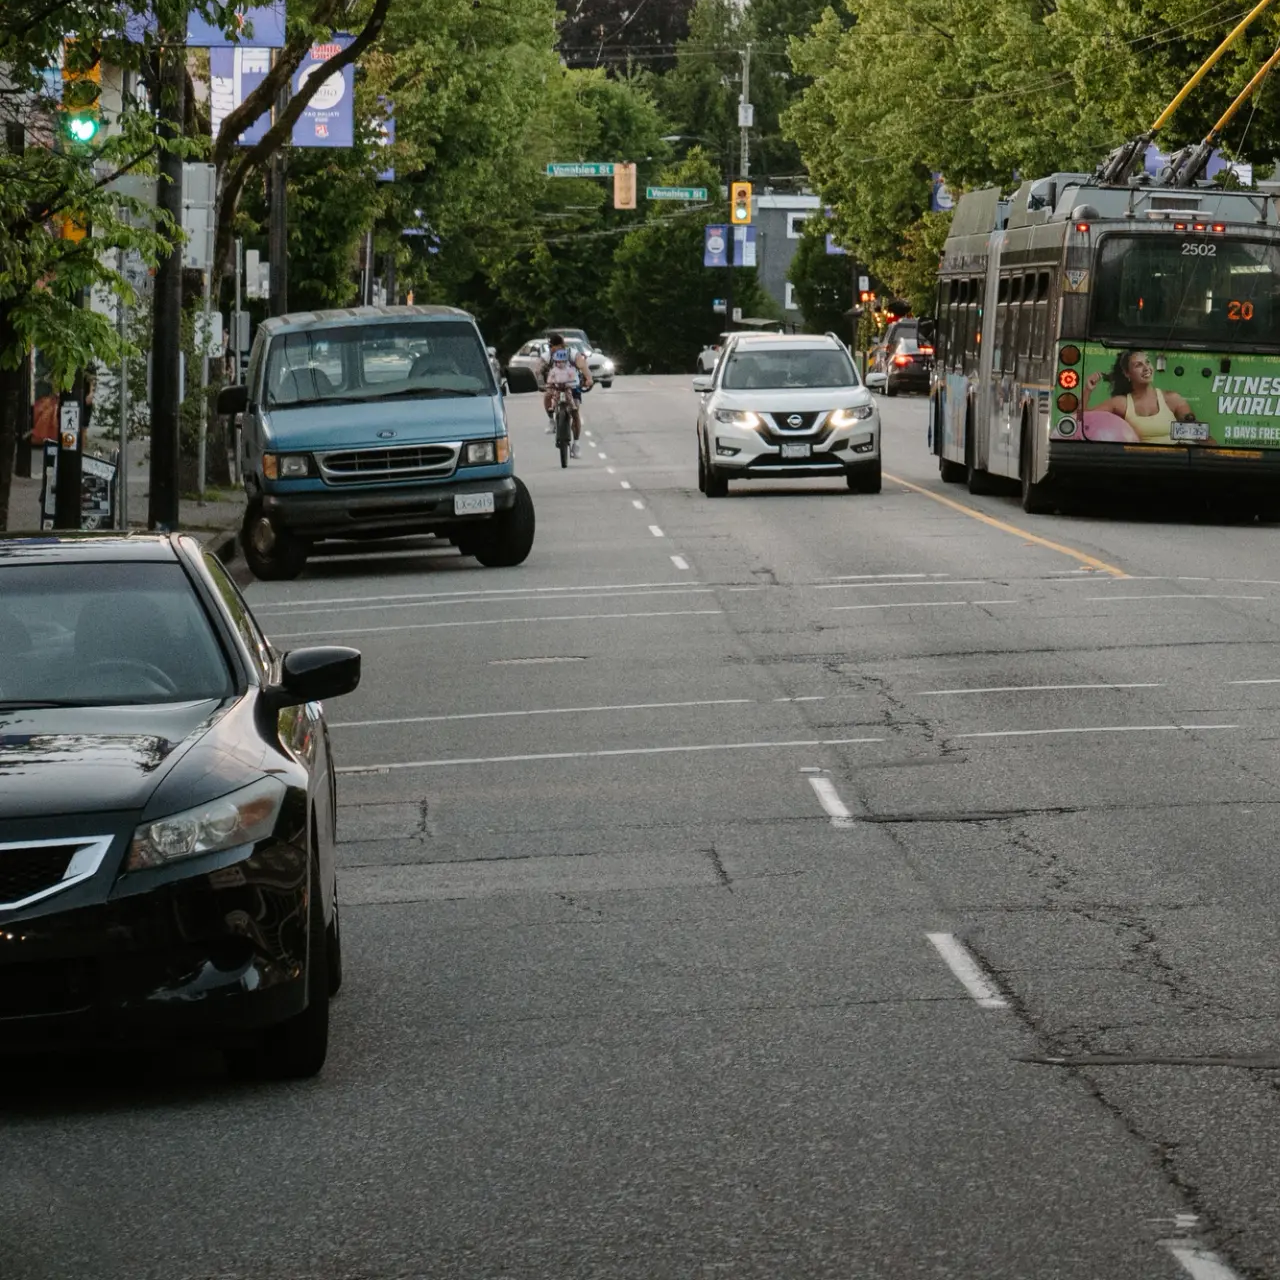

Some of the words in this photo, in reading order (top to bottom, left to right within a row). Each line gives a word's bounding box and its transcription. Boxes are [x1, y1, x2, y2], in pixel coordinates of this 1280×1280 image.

[553, 165, 595, 175] Venables
[600, 165, 611, 174] St
[651, 189, 689, 198] Venables
[693, 189, 703, 198] St
[1181, 243, 1216, 257] 2502
[1228, 300, 1254, 320] 20
[1225, 426, 1231, 438] 3
[1233, 426, 1257, 439] DAYS
[1260, 427, 1280, 439] FREE
